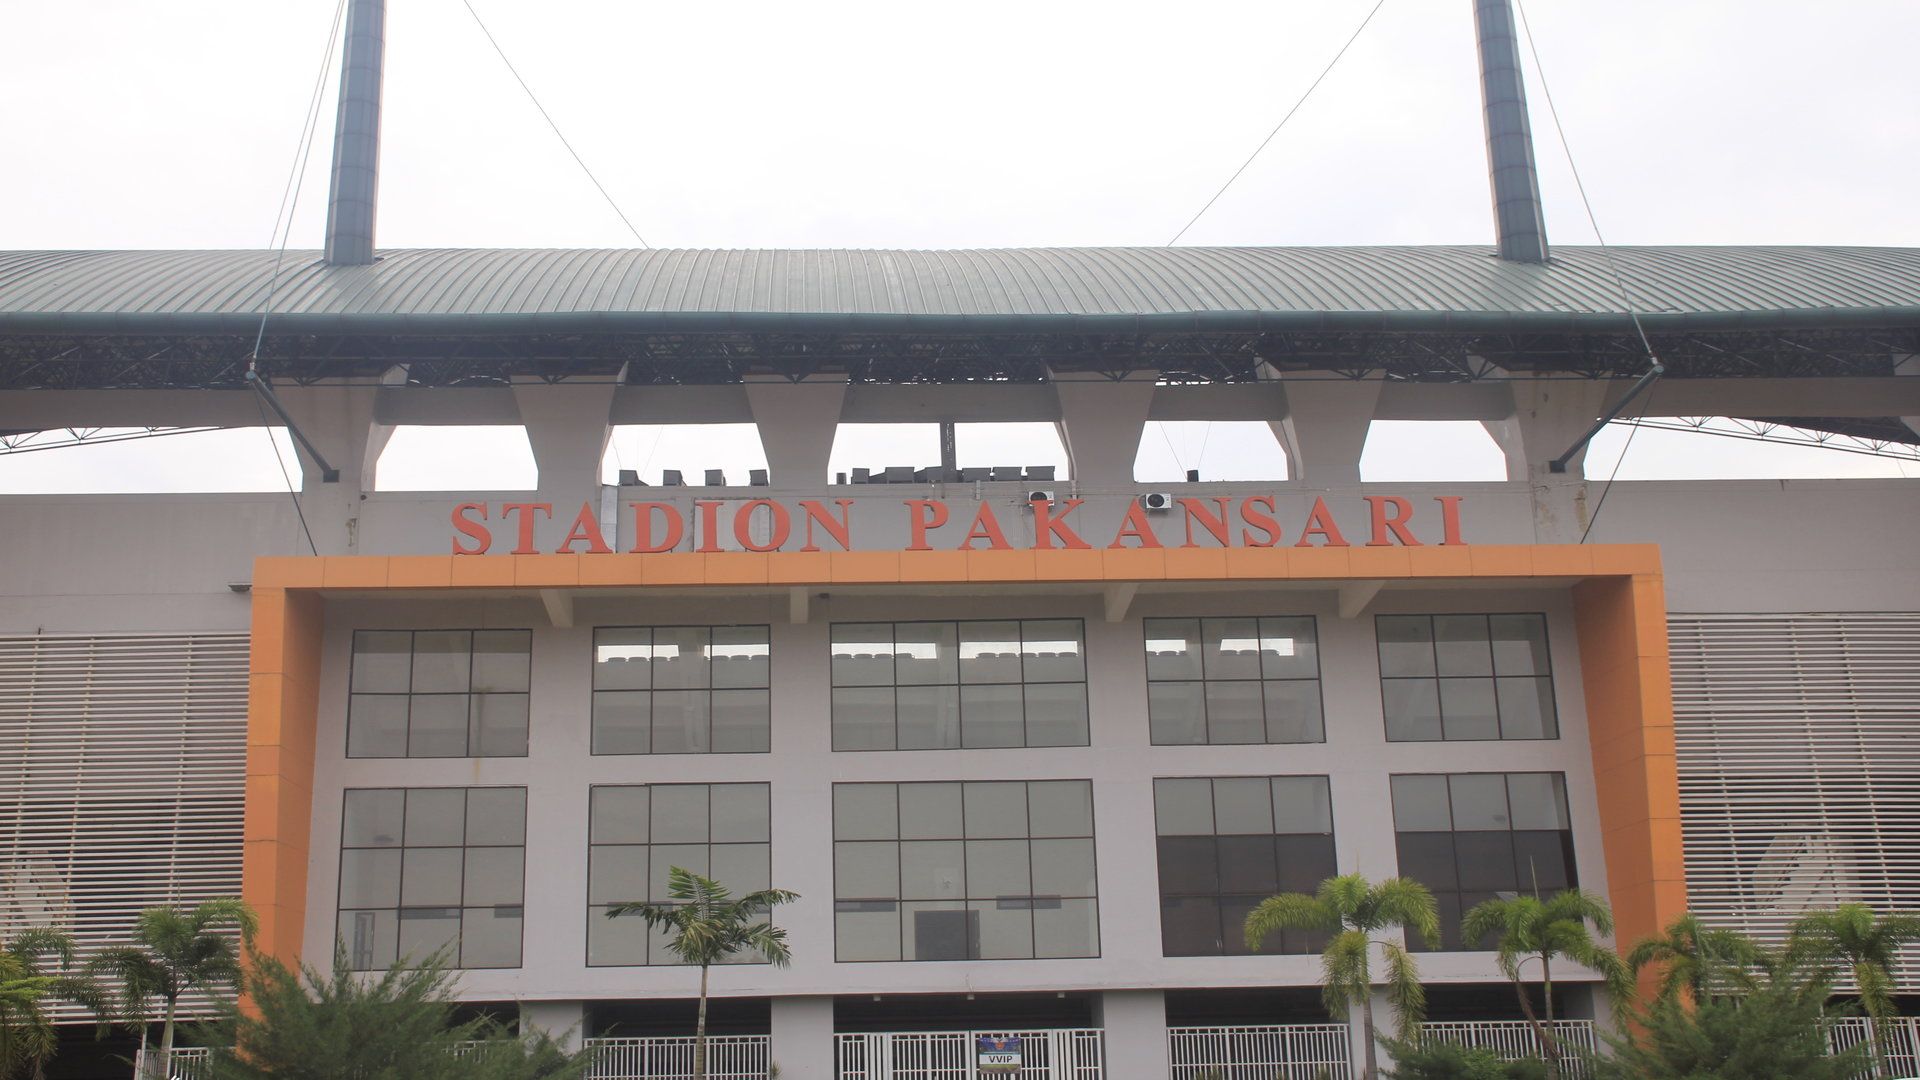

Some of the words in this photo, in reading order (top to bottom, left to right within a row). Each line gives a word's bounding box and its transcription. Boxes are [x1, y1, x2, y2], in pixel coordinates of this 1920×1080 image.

[451, 501, 854, 555] STADION
[904, 496, 1469, 551] PAKANSARI
[988, 1055, 1013, 1063] VVIP
